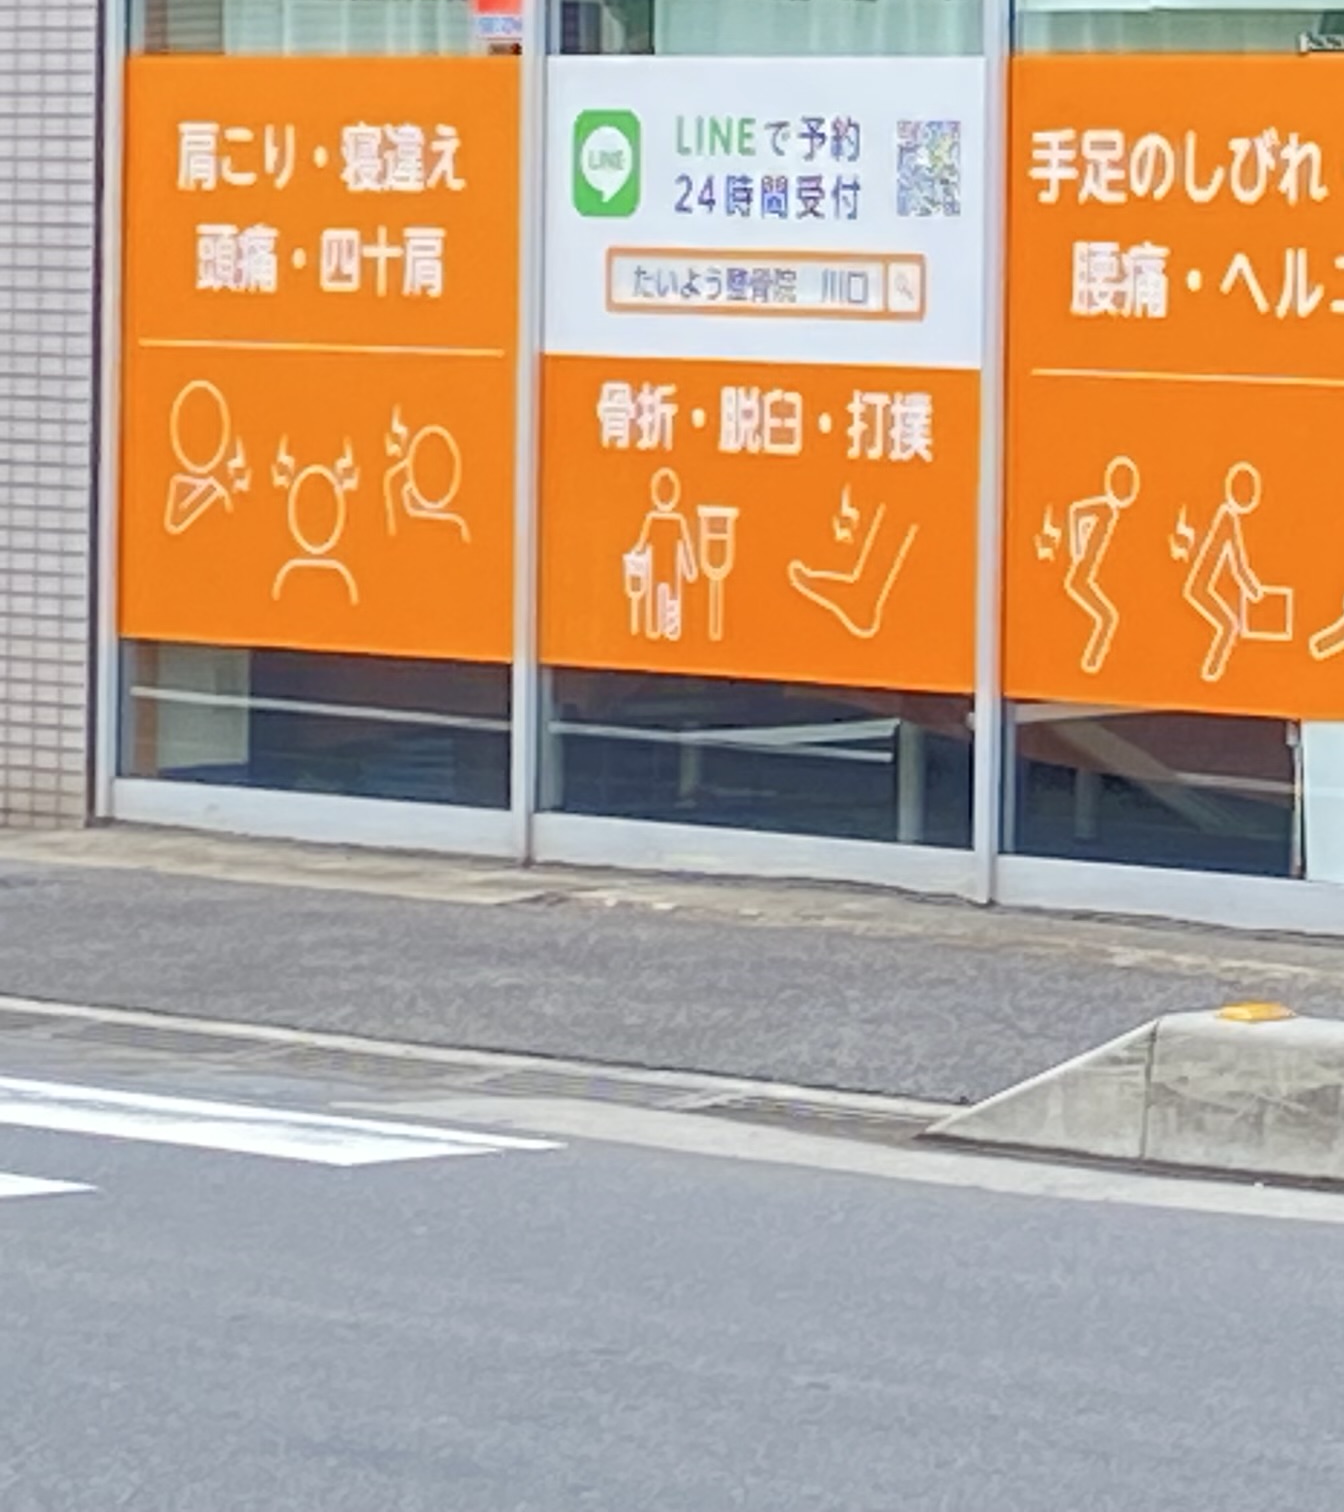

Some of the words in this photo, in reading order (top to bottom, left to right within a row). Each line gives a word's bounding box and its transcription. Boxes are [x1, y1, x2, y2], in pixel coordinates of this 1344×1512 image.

[177, 122, 466, 192] 肩こり・寝違え
[675, 115, 861, 162] LINEで予約
[674, 175, 861, 220] 24時間受付
[195, 224, 446, 297] 頭痛・四十肩
[632, 265, 797, 304] たいよう整骨院
[821, 268, 869, 304] 川口
[597, 381, 934, 463] 骨折・脱臼・打撲
